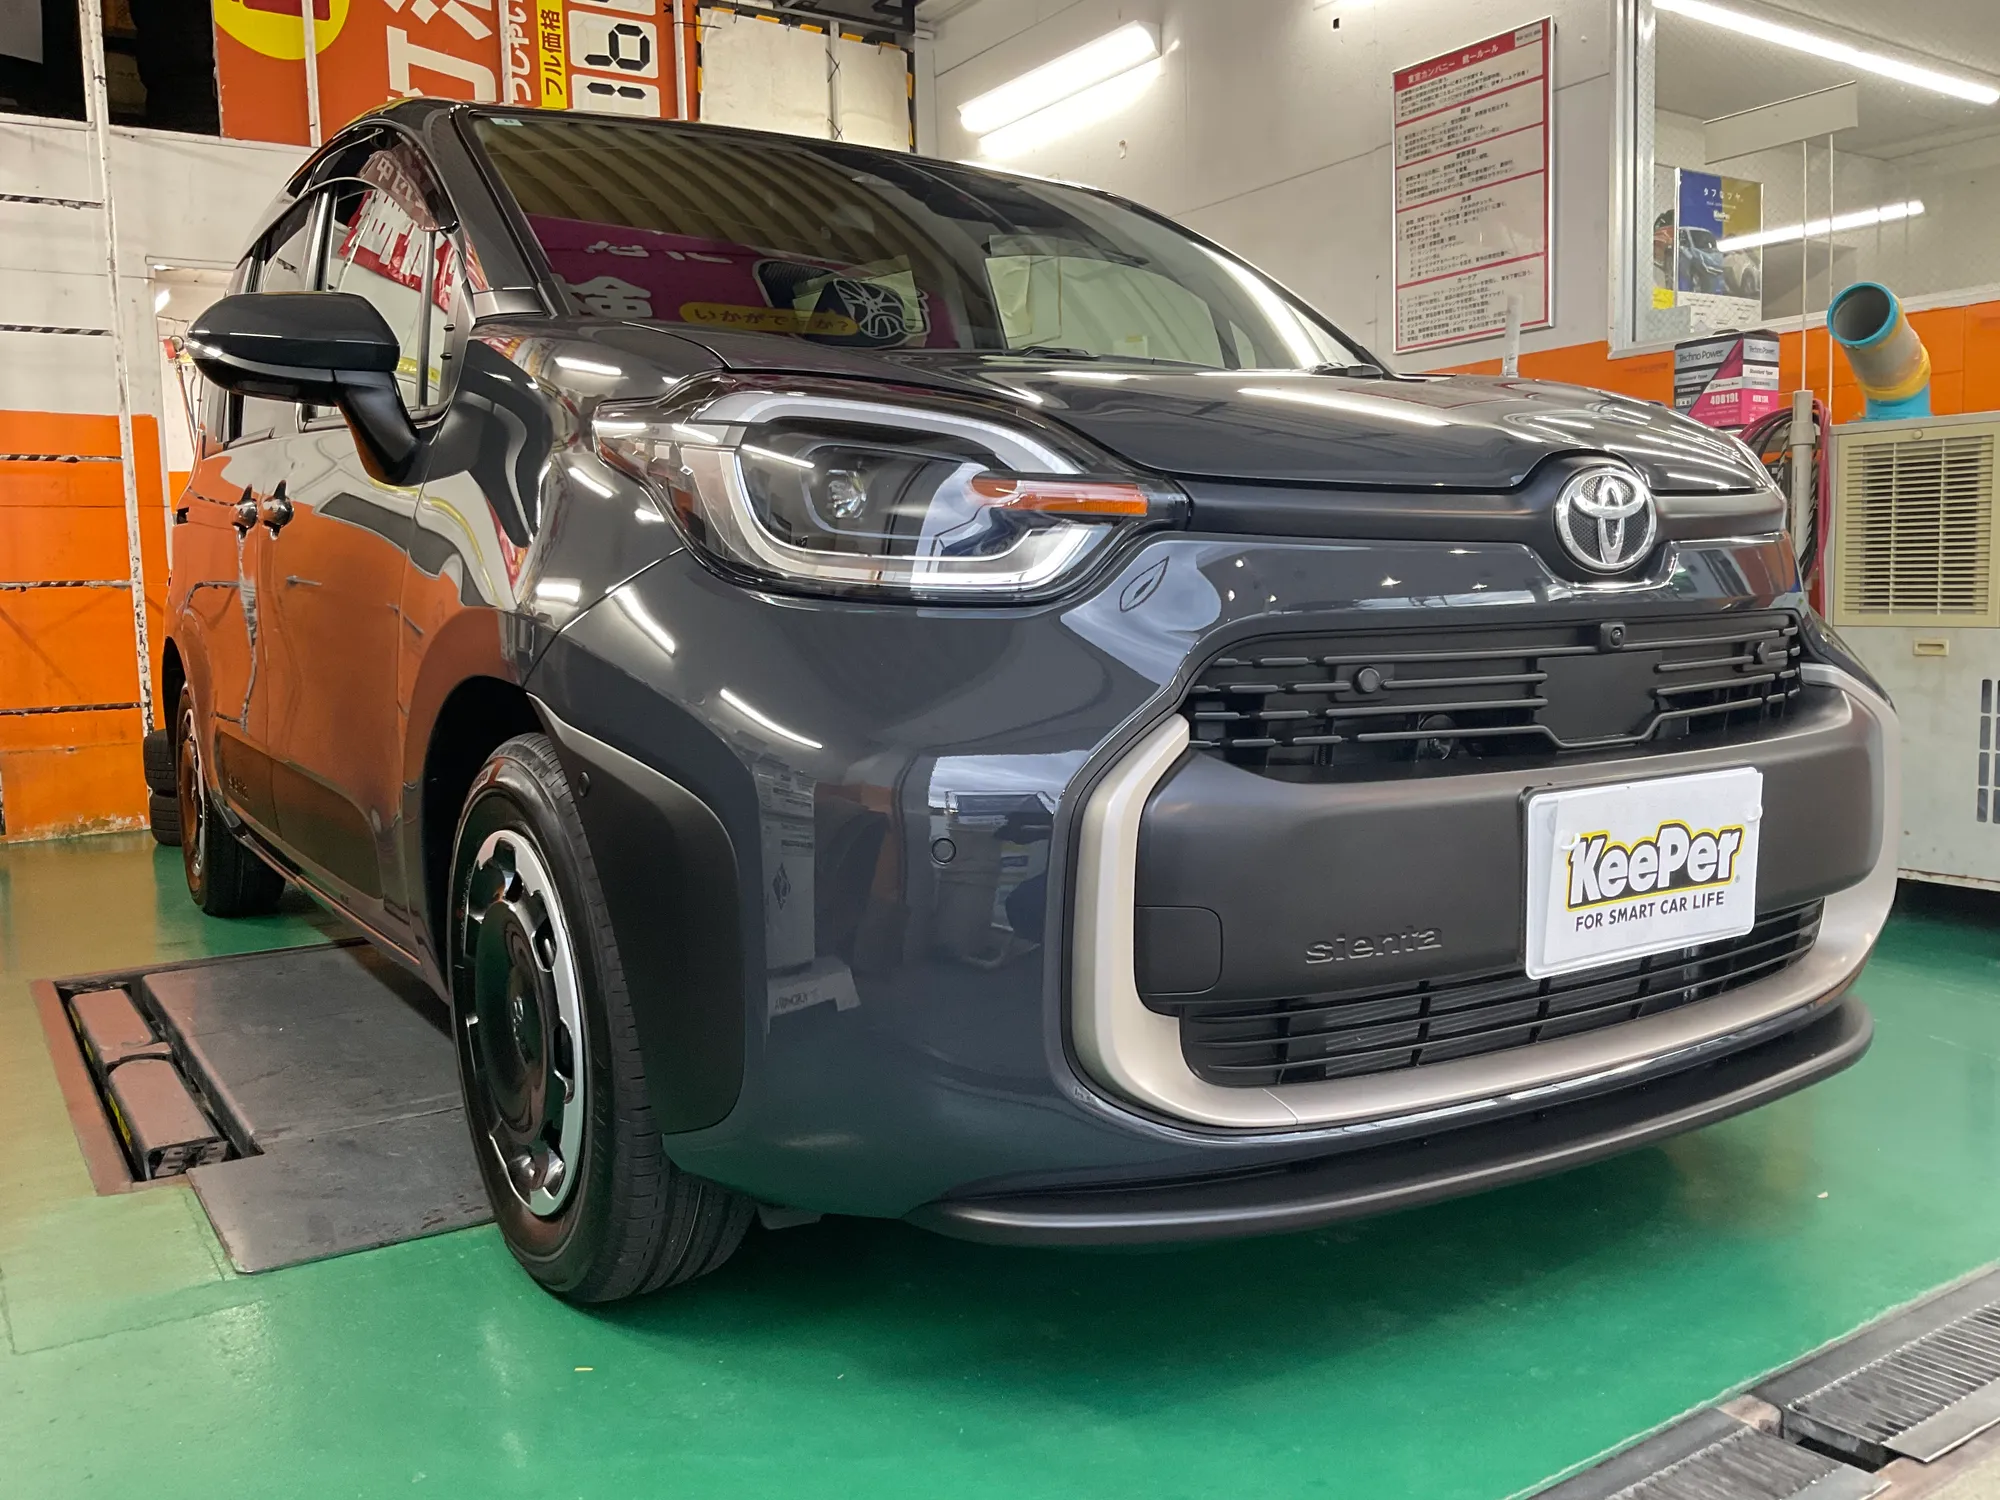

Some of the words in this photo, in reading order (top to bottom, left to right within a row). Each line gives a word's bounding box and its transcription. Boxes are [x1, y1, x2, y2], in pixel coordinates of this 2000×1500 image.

[540, 8, 563, 96] フル価格
[583, 0, 651, 100] 16
[1568, 823, 1742, 908] KeePer
[1305, 925, 1443, 964] sienta
[1575, 912, 1603, 932] FOR
[1608, 902, 1656, 925] SMART
[1660, 898, 1687, 915] CAR
[1692, 890, 1725, 909] LIFE
